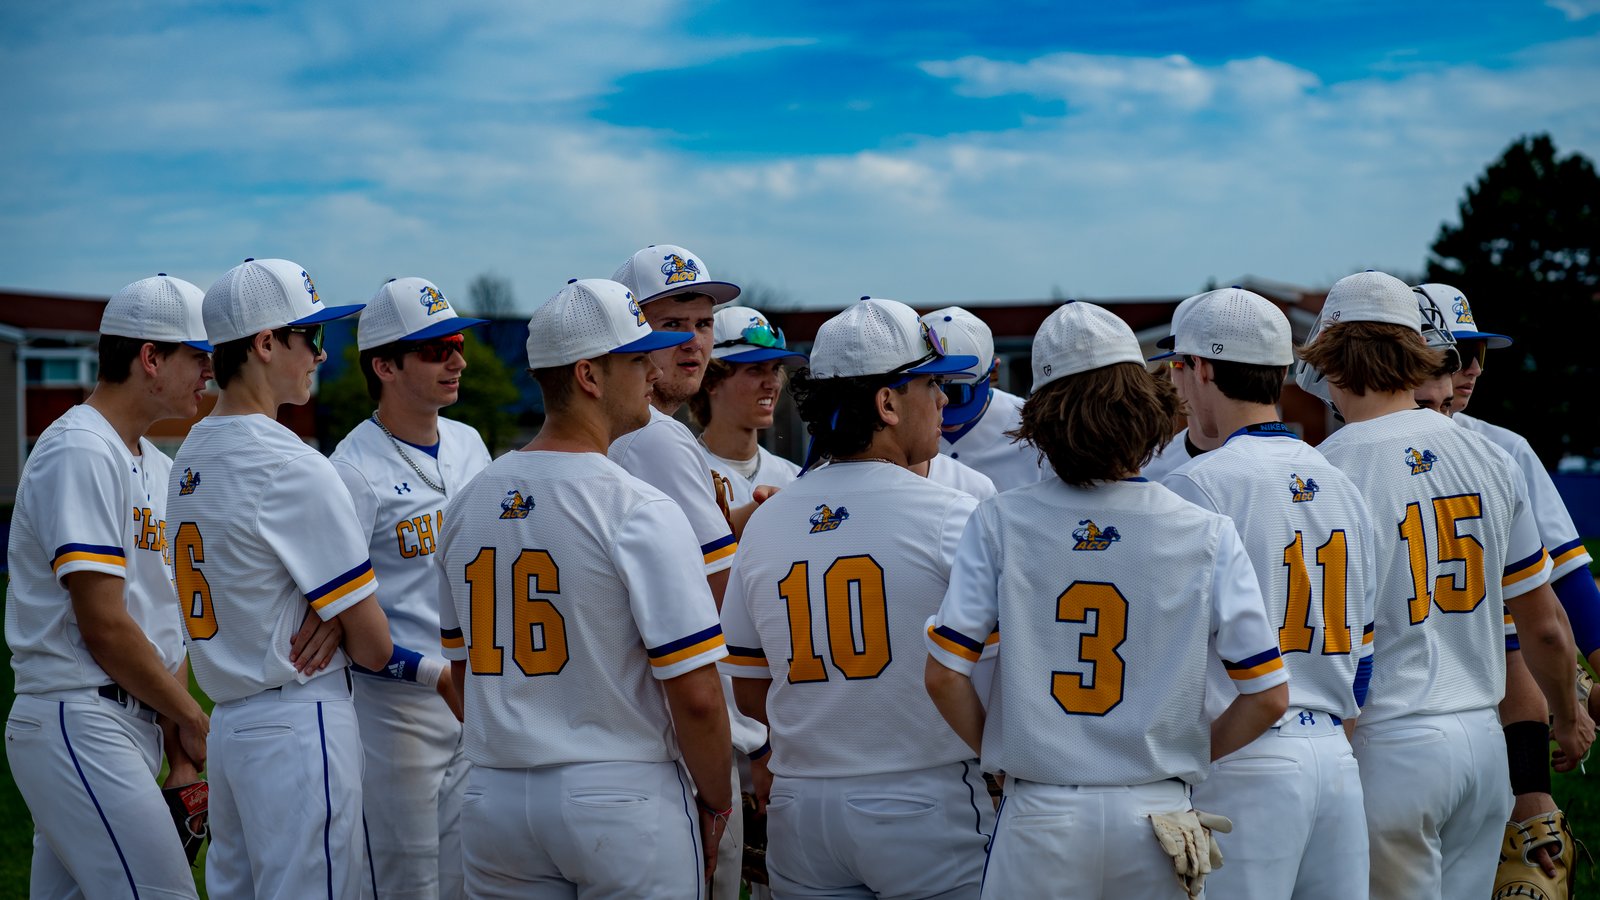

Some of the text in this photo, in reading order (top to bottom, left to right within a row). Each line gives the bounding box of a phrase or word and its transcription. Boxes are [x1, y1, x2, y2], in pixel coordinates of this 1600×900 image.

[500, 509, 529, 519] ACC
[810, 521, 840, 533] ACC
[1292, 491, 1314, 502] ACC
[1411, 463, 1432, 474] ACC
[174, 522, 219, 641] 6
[1073, 540, 1111, 550] ACC
[1279, 529, 1352, 656] 11
[1398, 493, 1486, 626] 15
[465, 547, 570, 677] 16
[778, 554, 892, 685] 10
[1050, 580, 1129, 717] 3
